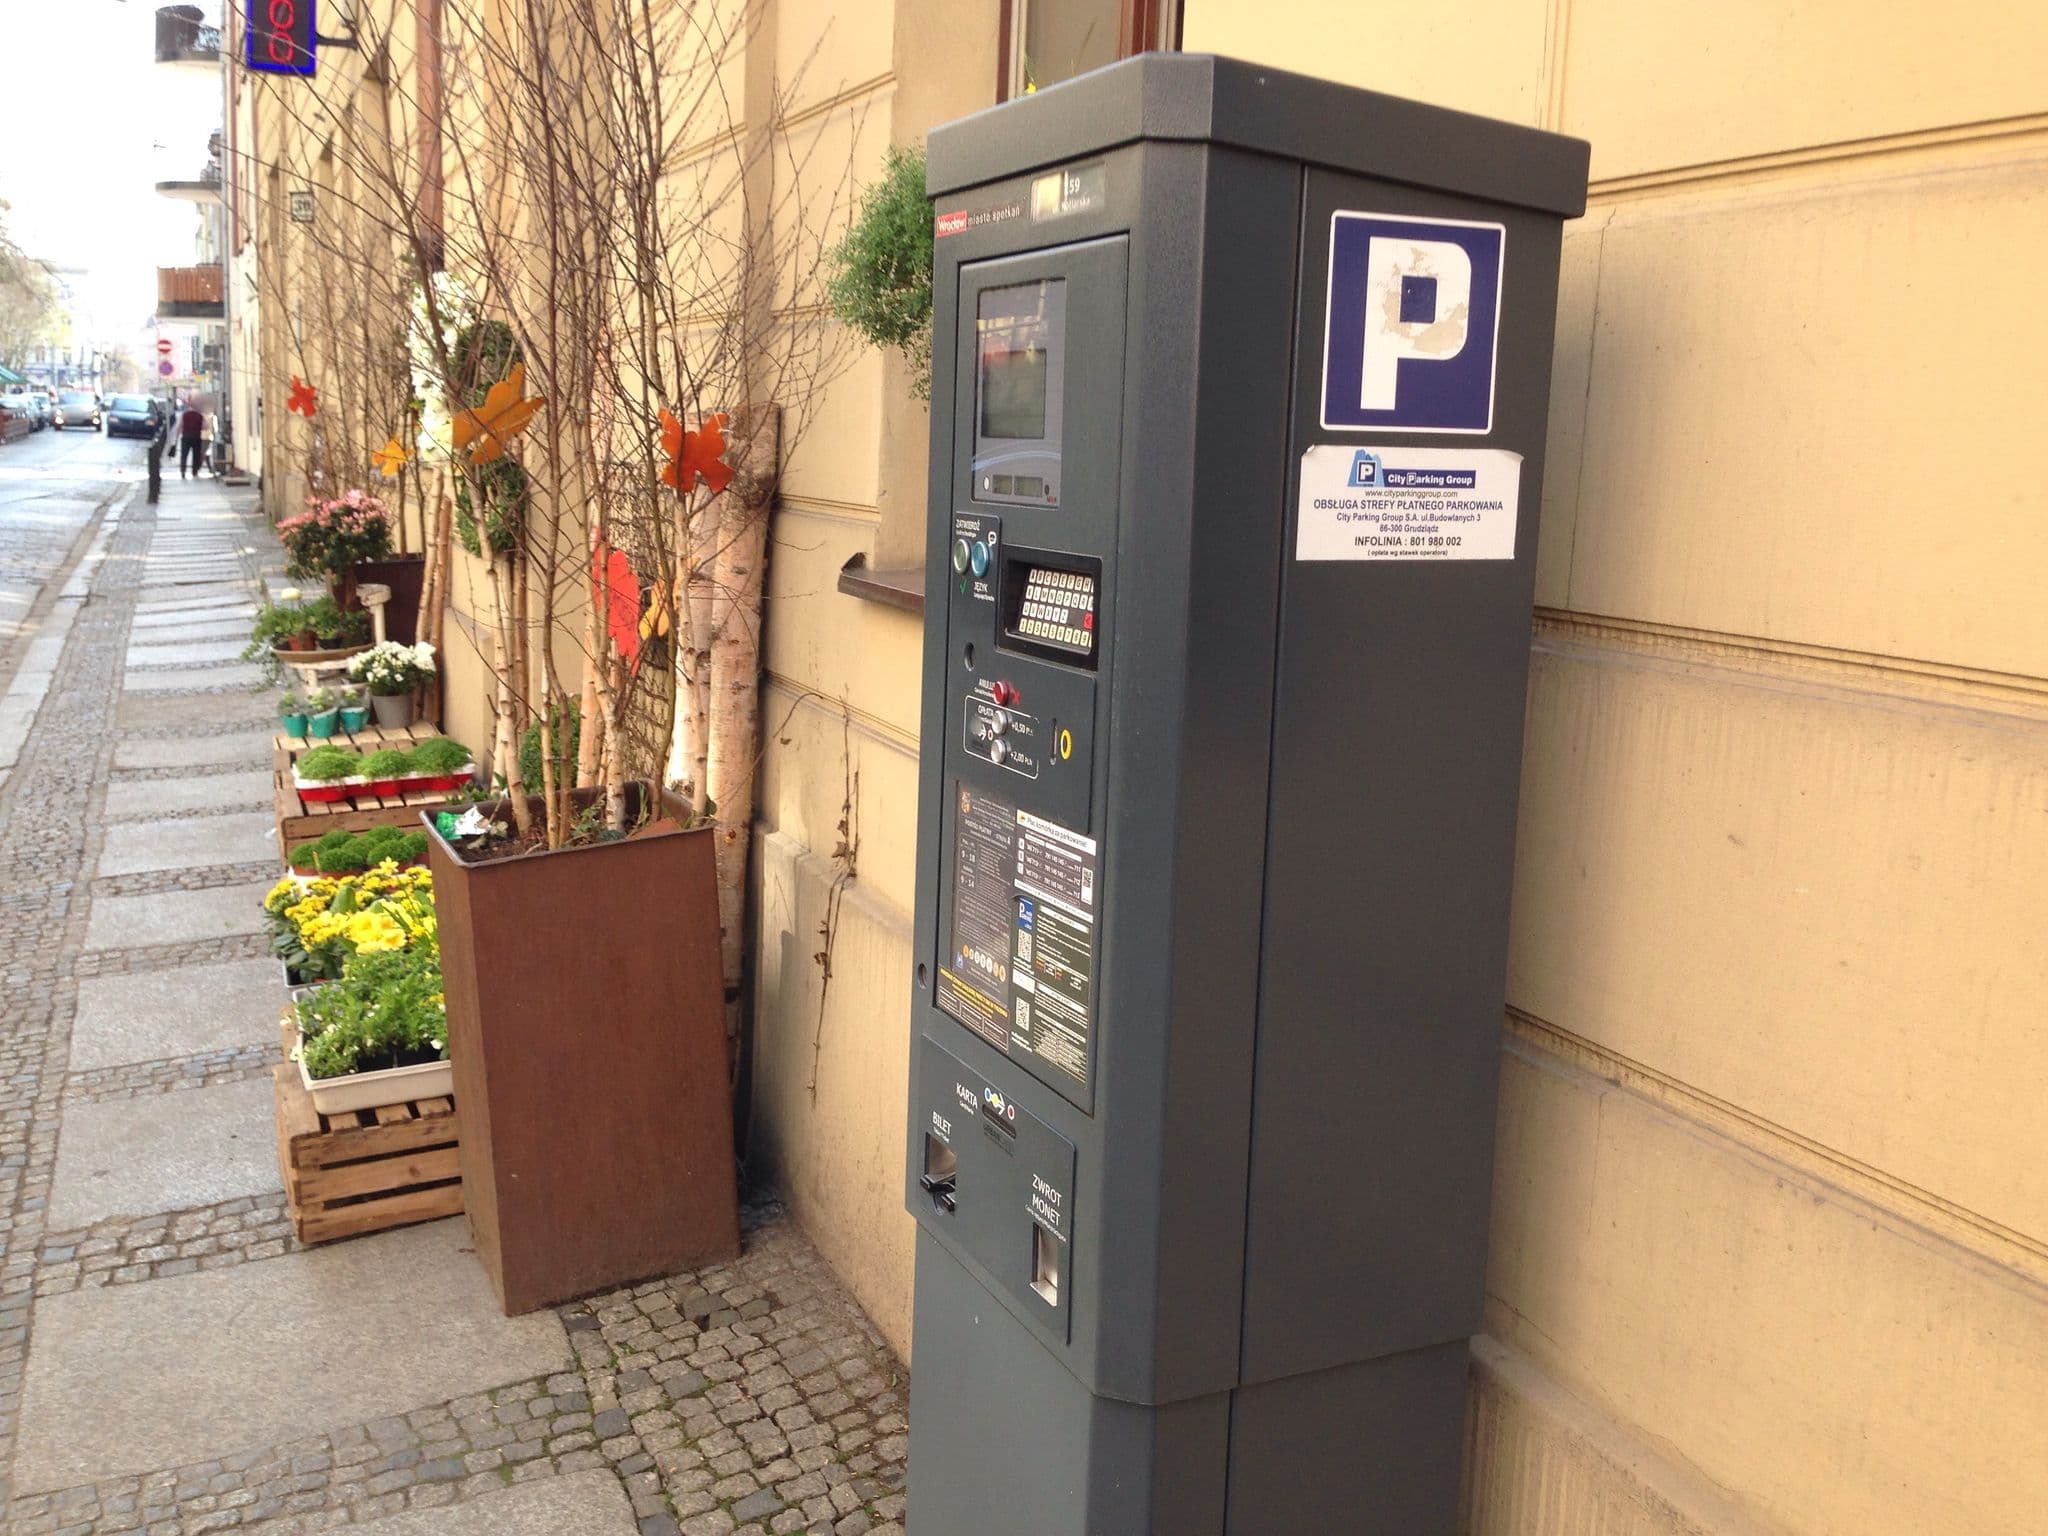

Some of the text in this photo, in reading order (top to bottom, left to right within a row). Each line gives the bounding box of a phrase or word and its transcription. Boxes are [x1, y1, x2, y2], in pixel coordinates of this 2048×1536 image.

[1360, 236, 1472, 411] P
[1387, 472, 1473, 487] City Parking Group
[1364, 489, 1458, 498] www.cityparkinggroup.com
[1313, 499, 1503, 511] OBSŁUGA STREFY PŁATNEGO PARKOWANIA
[1336, 512, 1351, 522] City
[1352, 512, 1380, 522] Parking
[1381, 513, 1404, 522] Group
[1405, 513, 1419, 522] S.A.
[1476, 513, 1481, 522] 3
[1404, 524, 1439, 534] Grudziądz
[1354, 536, 1401, 546] INFOLINIA
[1410, 537, 1425, 546] 801
[1428, 537, 1443, 546] 980
[1445, 537, 1461, 546] 002
[956, 1082, 978, 1109] KARTA
[932, 1110, 951, 1135] BILET
[1032, 1173, 1062, 1207] ZWROT
[1032, 1193, 1061, 1226] MONET
